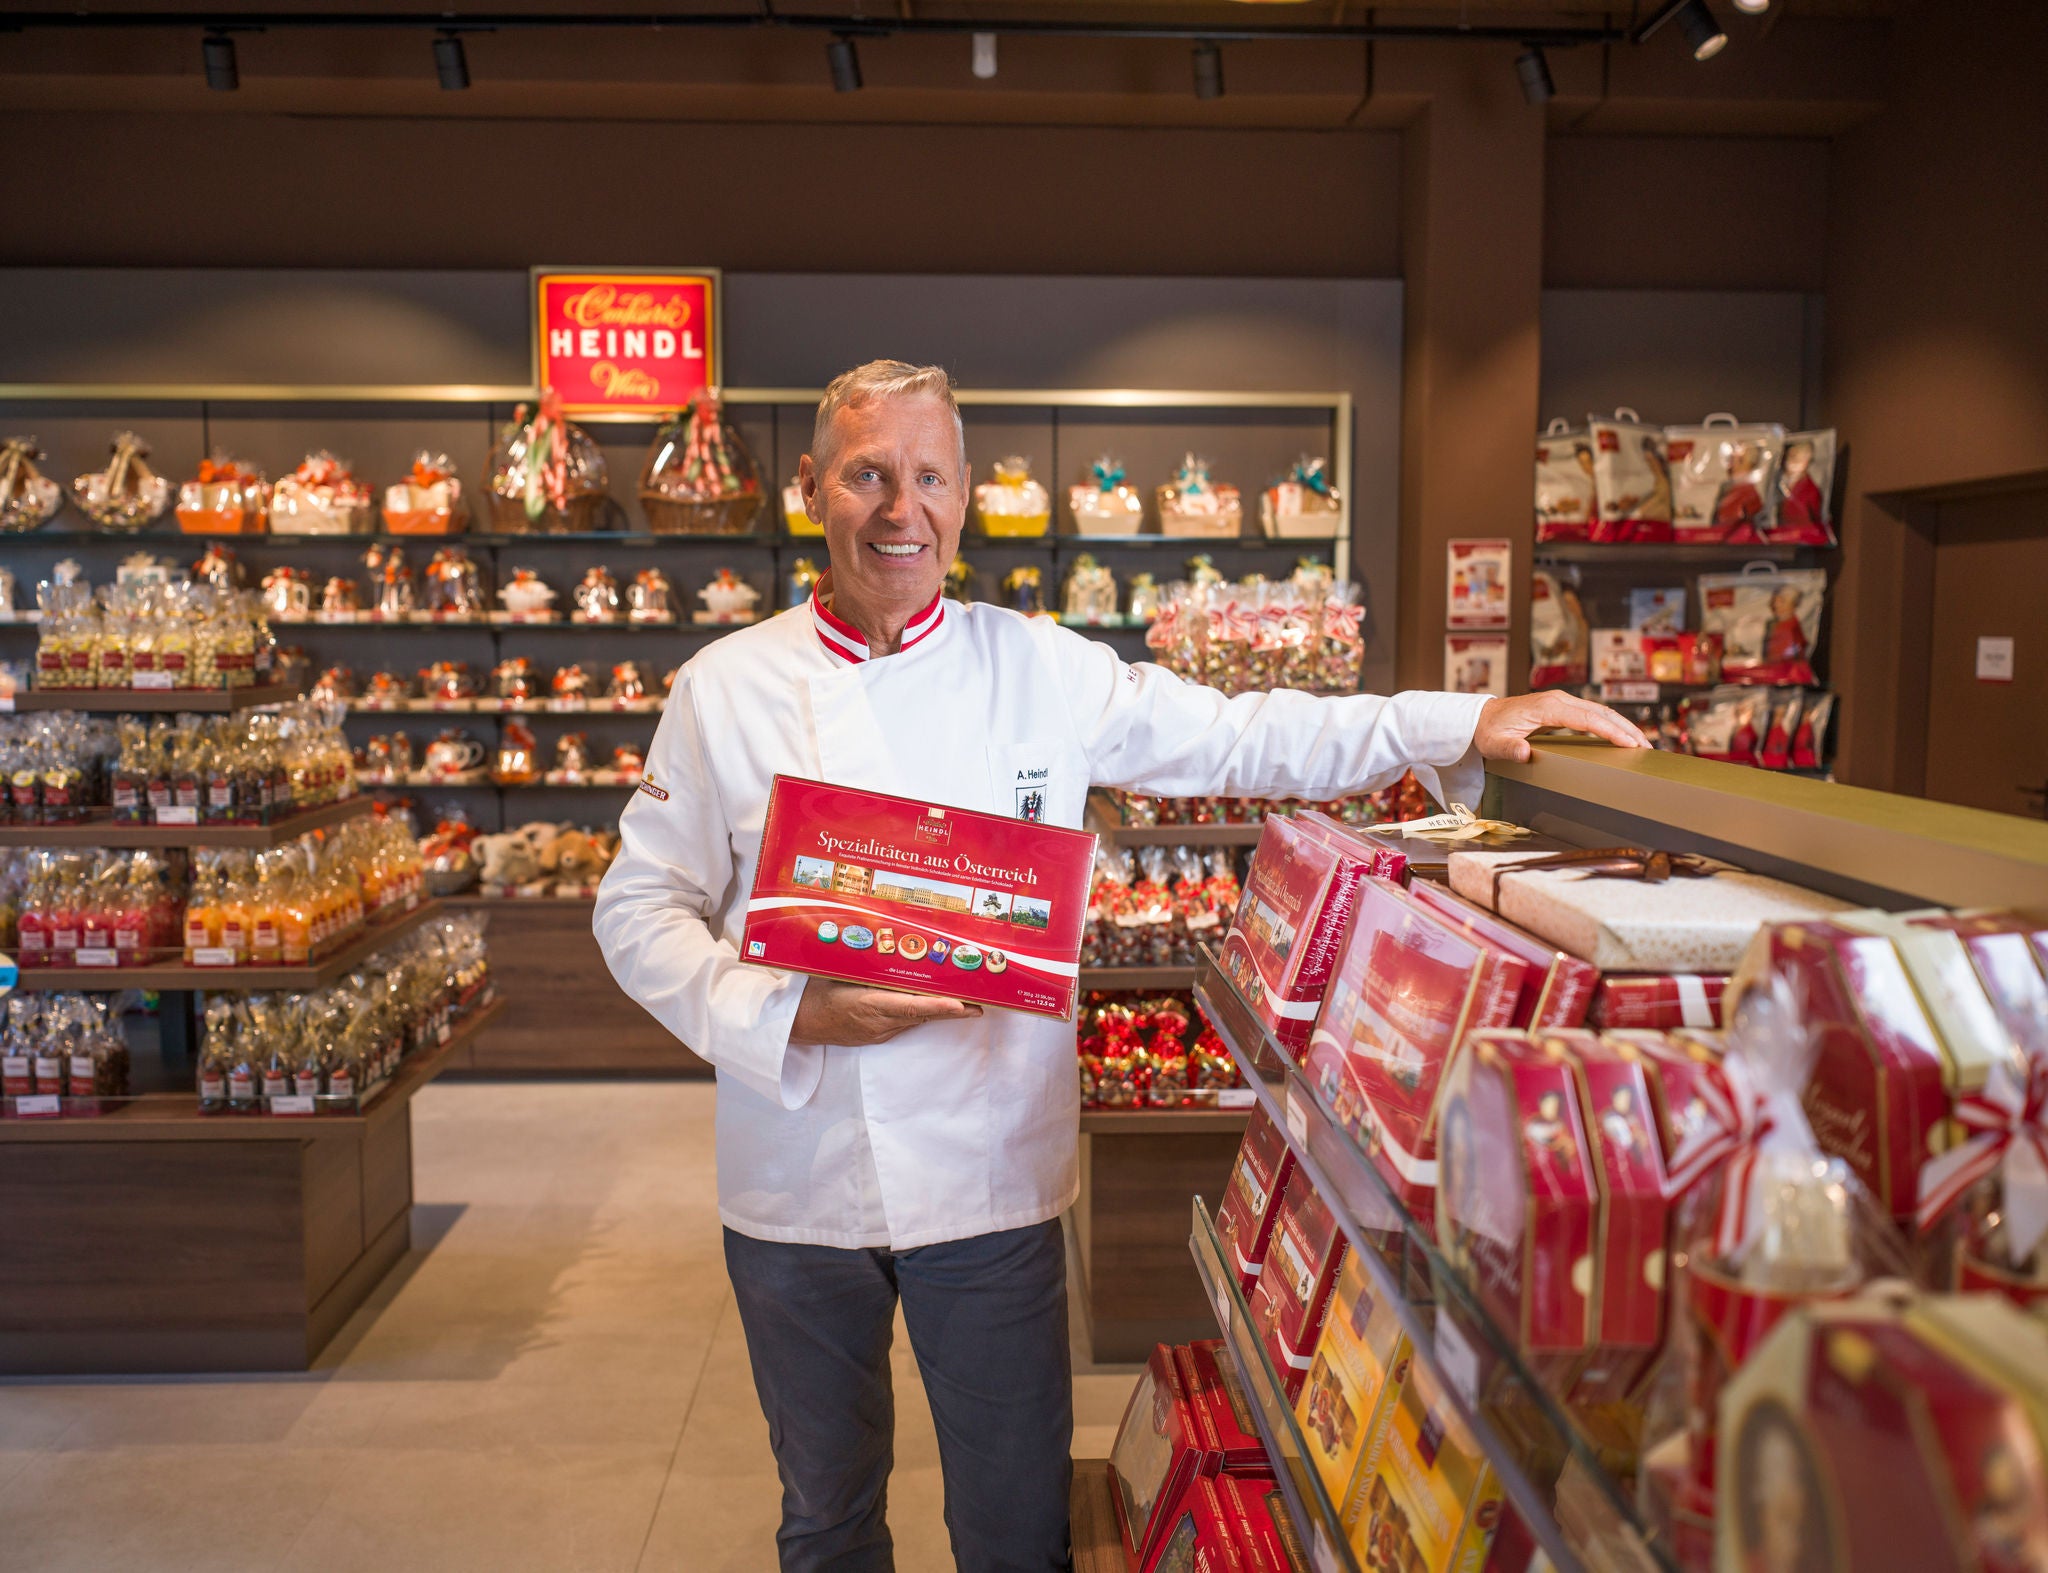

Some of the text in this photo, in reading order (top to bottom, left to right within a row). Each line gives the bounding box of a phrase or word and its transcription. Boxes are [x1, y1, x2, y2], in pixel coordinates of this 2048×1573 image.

[550, 329, 702, 359] HEINDL
[1017, 769, 1026, 780] A.
[1428, 819, 1466, 827] HEINDL
[919, 825, 949, 836] HEINDL
[817, 830, 1038, 885] Spezialitäten aus Österreich
